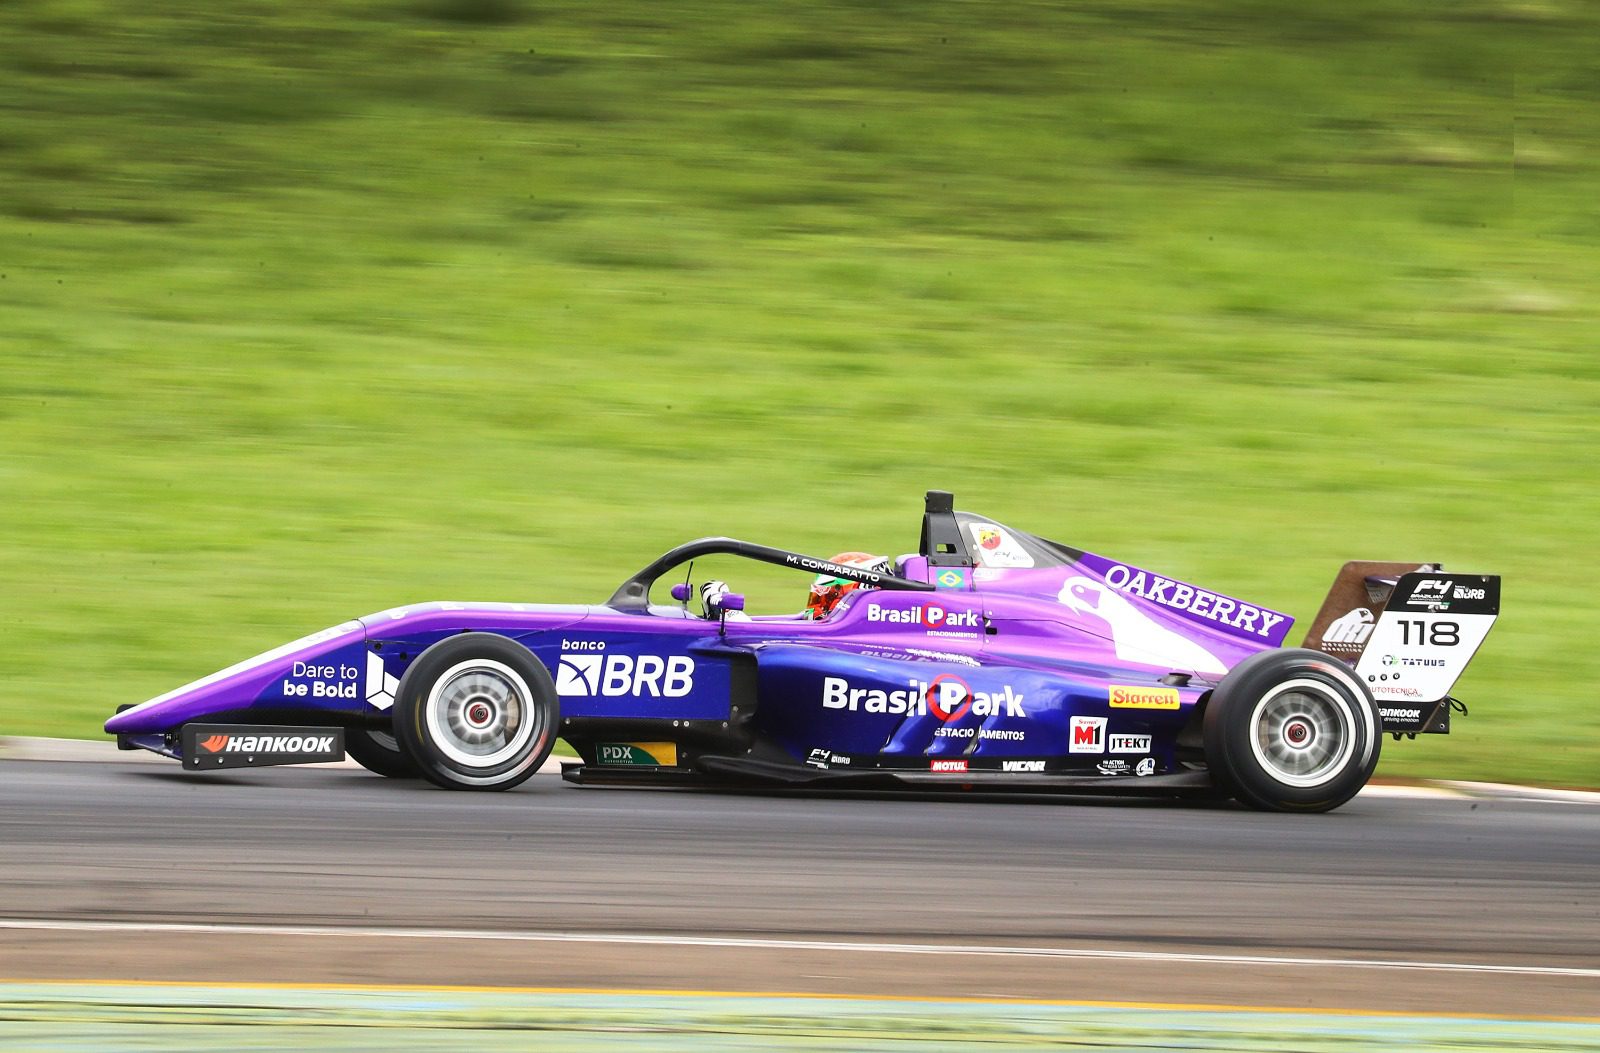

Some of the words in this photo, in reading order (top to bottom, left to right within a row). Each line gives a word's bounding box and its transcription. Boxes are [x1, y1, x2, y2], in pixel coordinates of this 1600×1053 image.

[785, 554, 799, 565] M.
[801, 558, 880, 582] COMPARATTO
[1413, 579, 1453, 595] F4
[1464, 588, 1486, 600] BRB
[1104, 565, 1284, 637] OAKBERRY
[926, 630, 978, 639] ESTACIONAMENTOS
[1397, 620, 1460, 647] 118
[561, 638, 606, 650] banco
[1401, 657, 1446, 667] TATUUS
[293, 661, 335, 679] Dare
[340, 662, 358, 679] to
[602, 655, 695, 697] BRB
[283, 680, 307, 697] be
[312, 681, 357, 699] Bold
[1379, 707, 1421, 718] ANKOOK
[934, 727, 1025, 740] ESTACIOAMENTOS
[1074, 725, 1101, 745] M1
[1111, 738, 1151, 751] JTEKT
[602, 747, 633, 759] PDX
[810, 748, 831, 759] F4
[932, 761, 967, 771] MOTUL
[1002, 761, 1046, 772] VICAR
